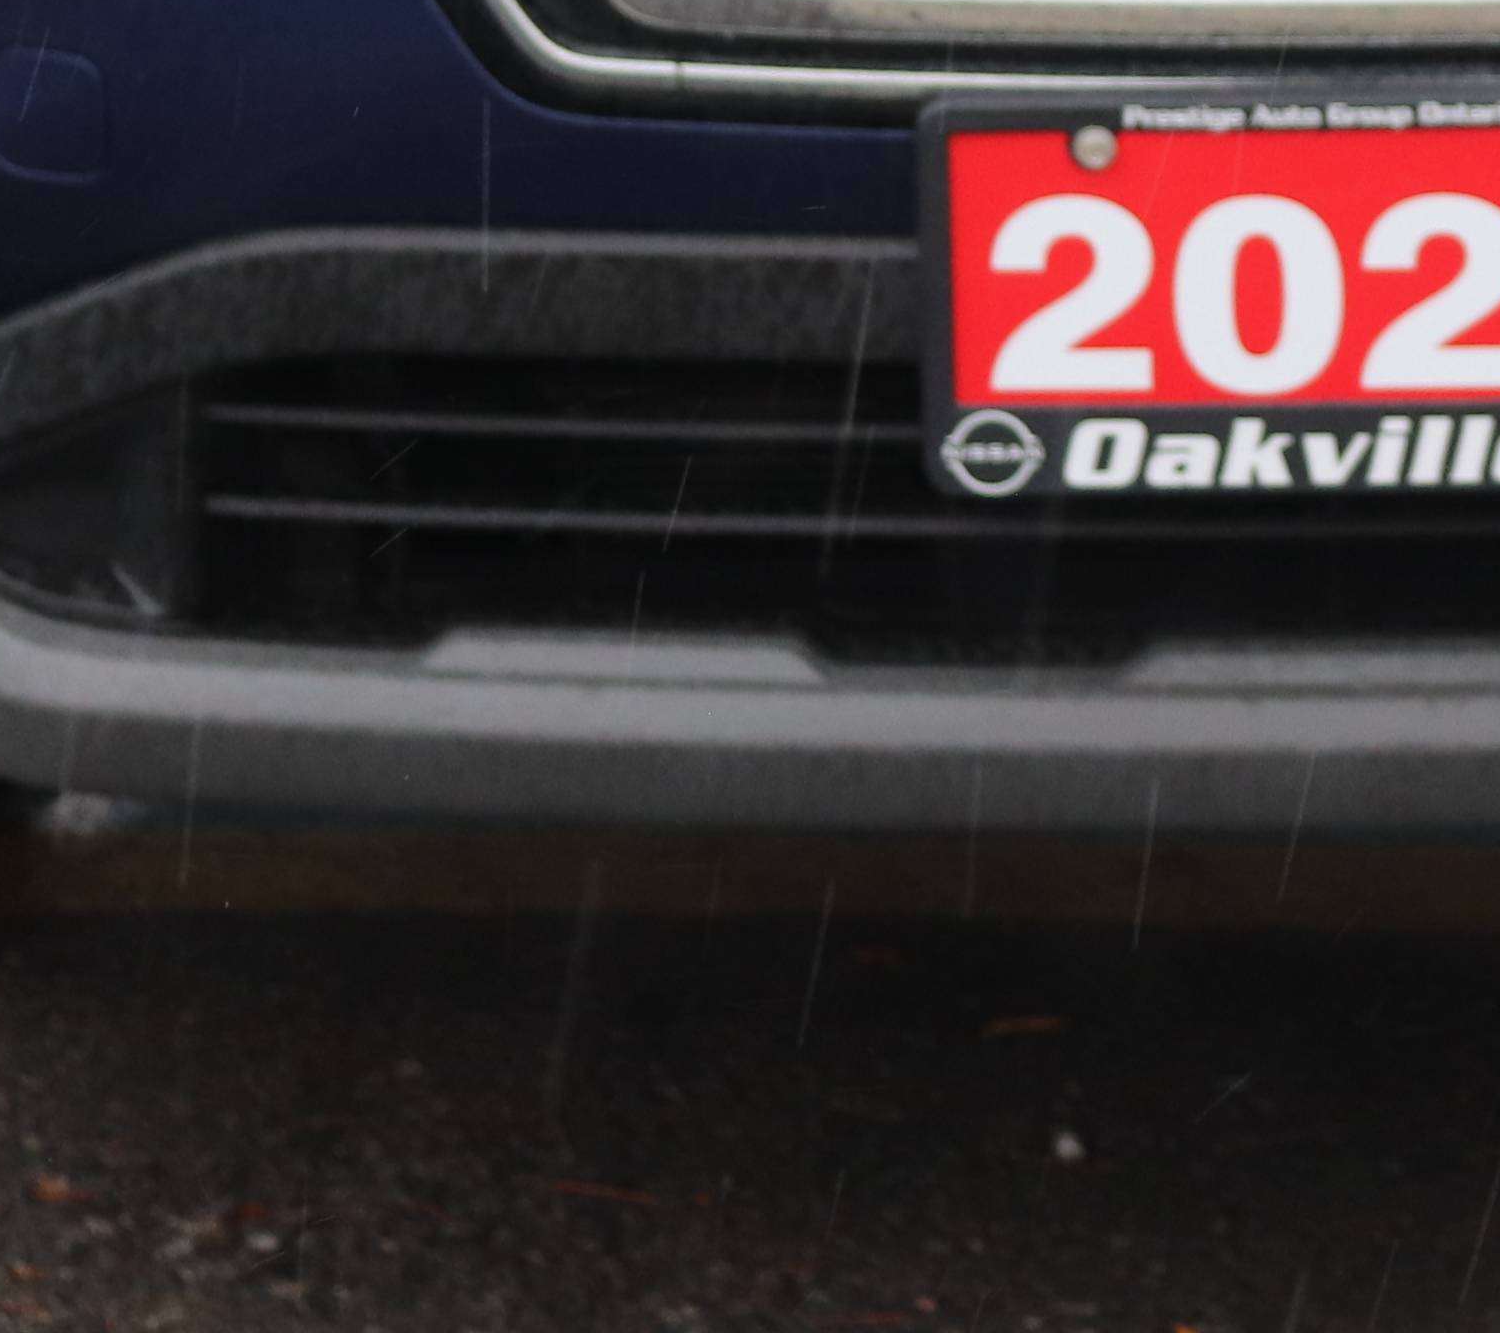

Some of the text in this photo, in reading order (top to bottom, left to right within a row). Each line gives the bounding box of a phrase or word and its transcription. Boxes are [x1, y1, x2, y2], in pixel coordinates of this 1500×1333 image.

[1122, 103, 1247, 133] Prestige
[1252, 103, 1323, 129] Auto
[1326, 101, 1415, 130] Group
